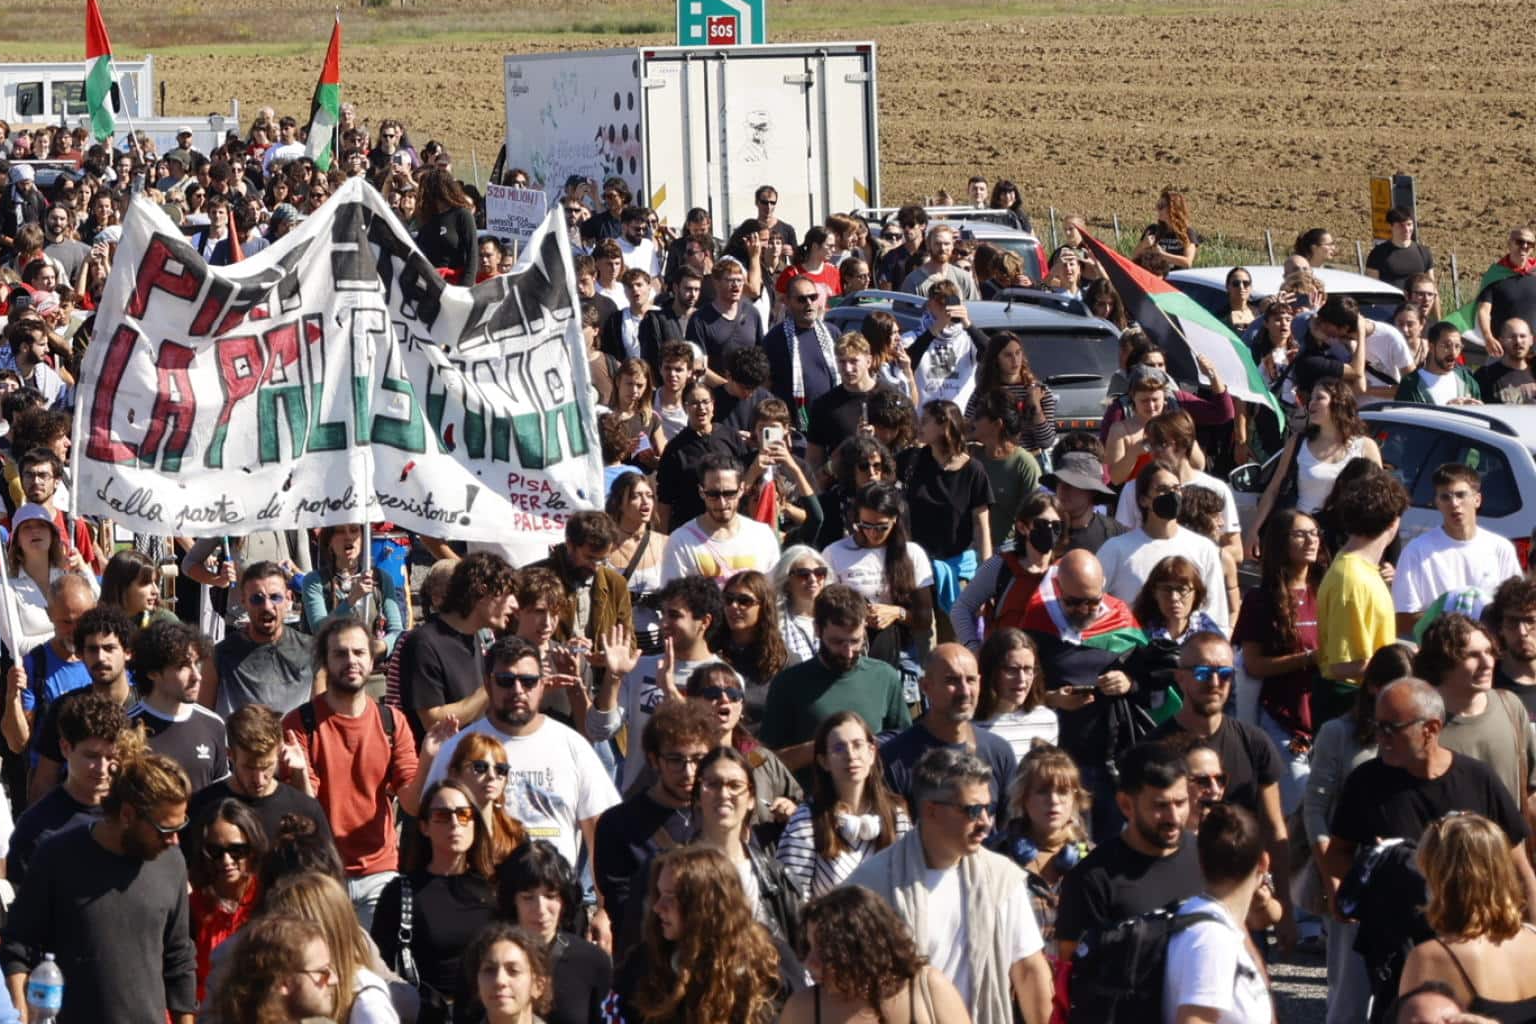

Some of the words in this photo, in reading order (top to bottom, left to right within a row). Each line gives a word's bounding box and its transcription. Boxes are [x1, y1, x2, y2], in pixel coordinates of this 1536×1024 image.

[710, 24, 733, 38] SOS
[487, 184, 505, 199] 520
[85, 323, 200, 473] LA
[507, 472, 553, 494] PISA
[96, 476, 164, 522] dalla
[175, 494, 245, 529] parte
[295, 484, 359, 523] popoli
[511, 492, 542, 511] PER
[543, 493, 569, 511] la
[514, 511, 571, 532] PALES
